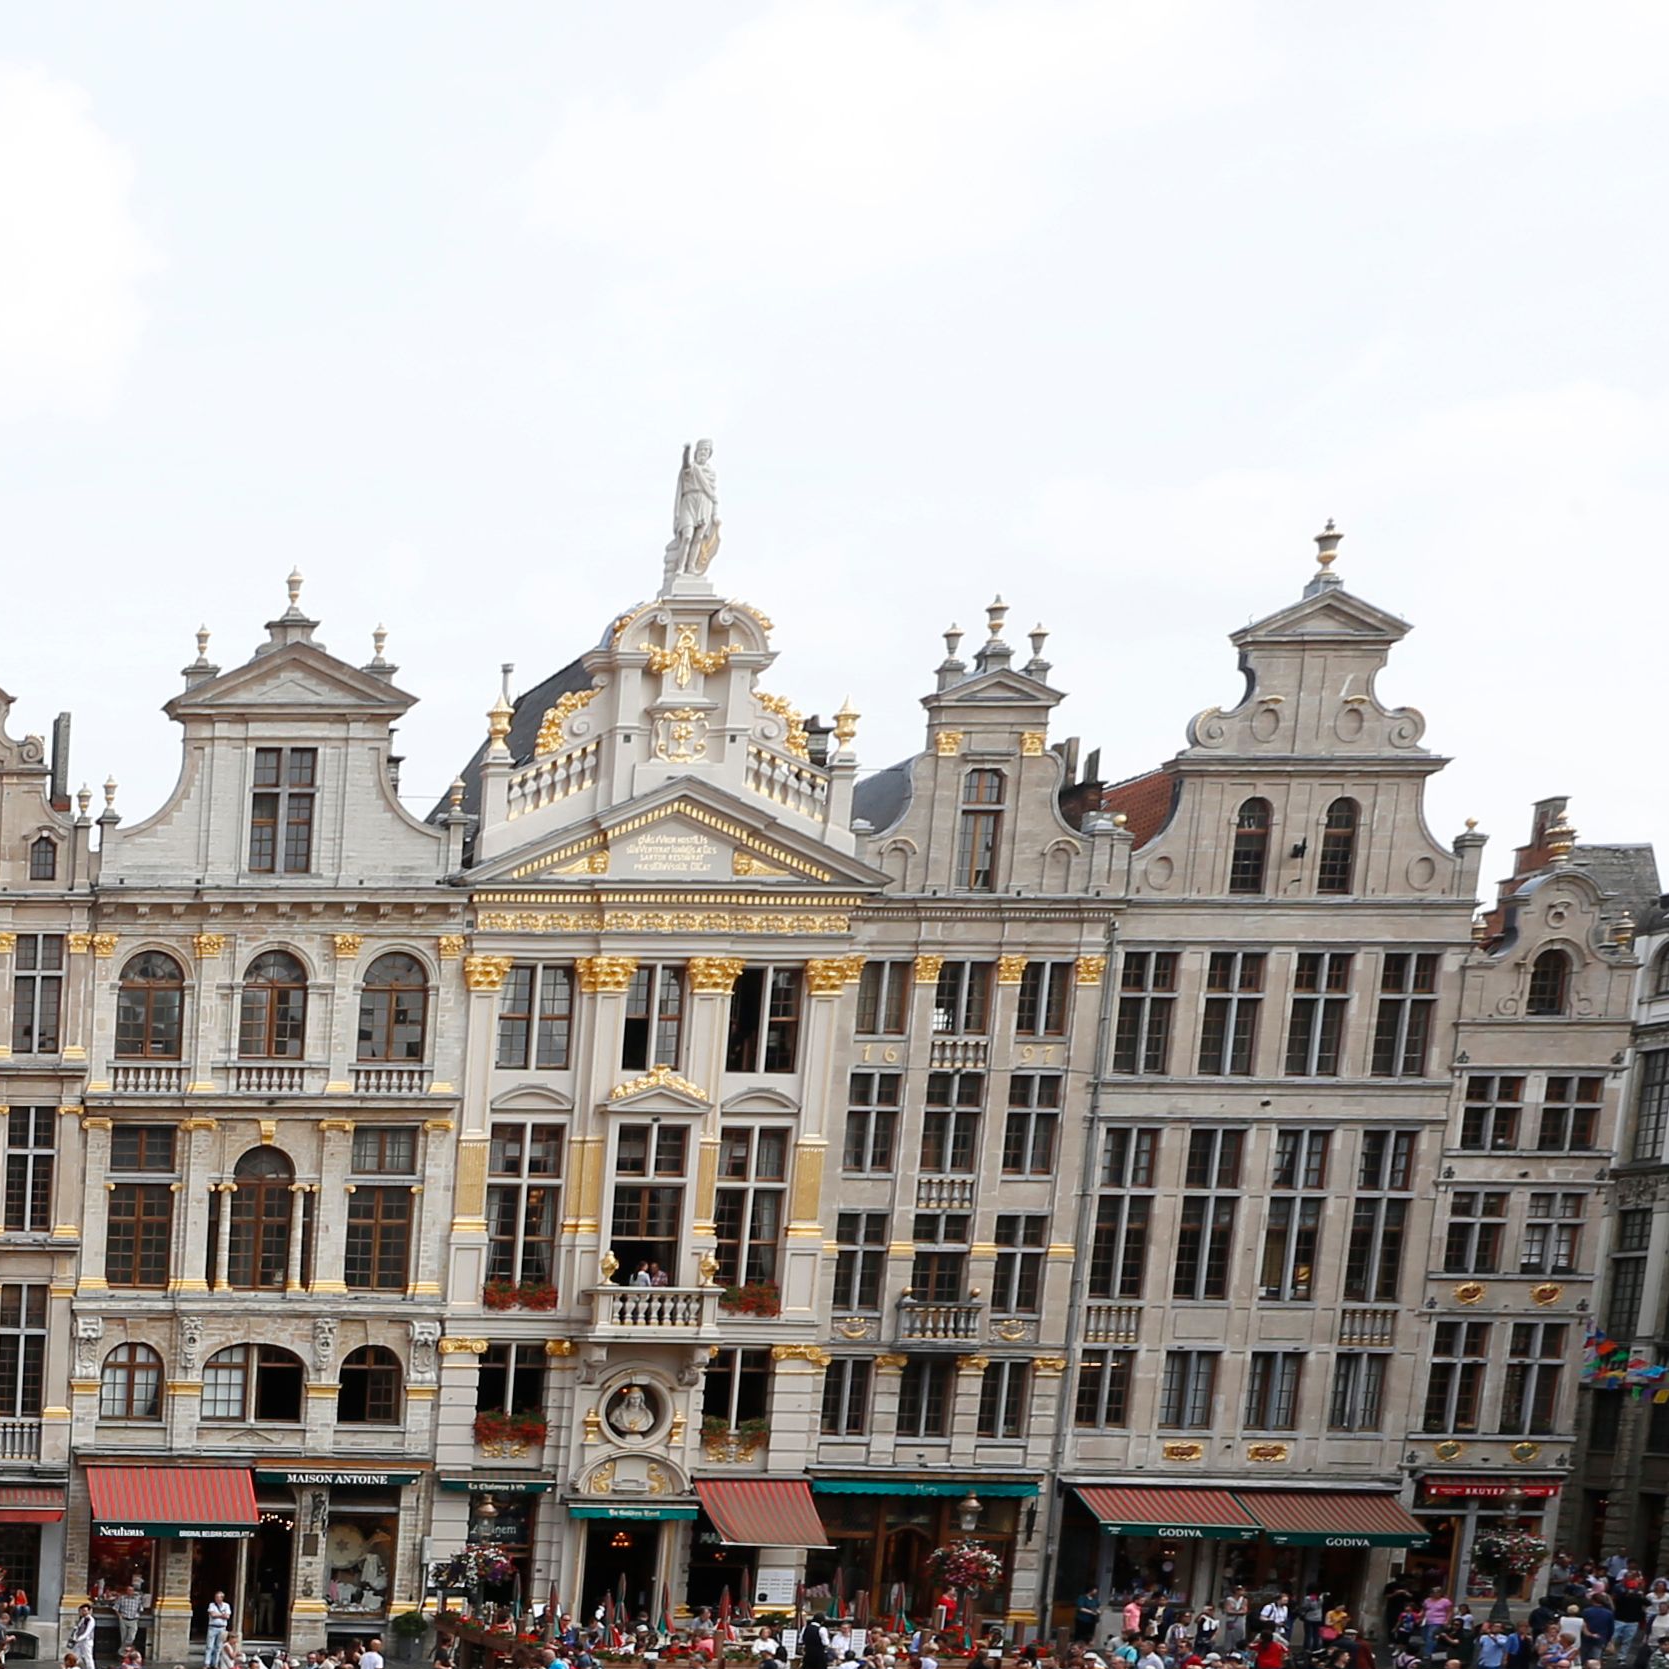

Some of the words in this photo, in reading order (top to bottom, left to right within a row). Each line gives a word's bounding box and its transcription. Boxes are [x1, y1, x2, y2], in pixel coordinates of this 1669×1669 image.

[286, 1473, 333, 1484] MAISON
[334, 1474, 388, 1485] ANTOINE
[99, 1525, 145, 1537] Neuhaus
[1158, 1527, 1203, 1538] GODIVA
[1325, 1537, 1371, 1547] GODIVA
